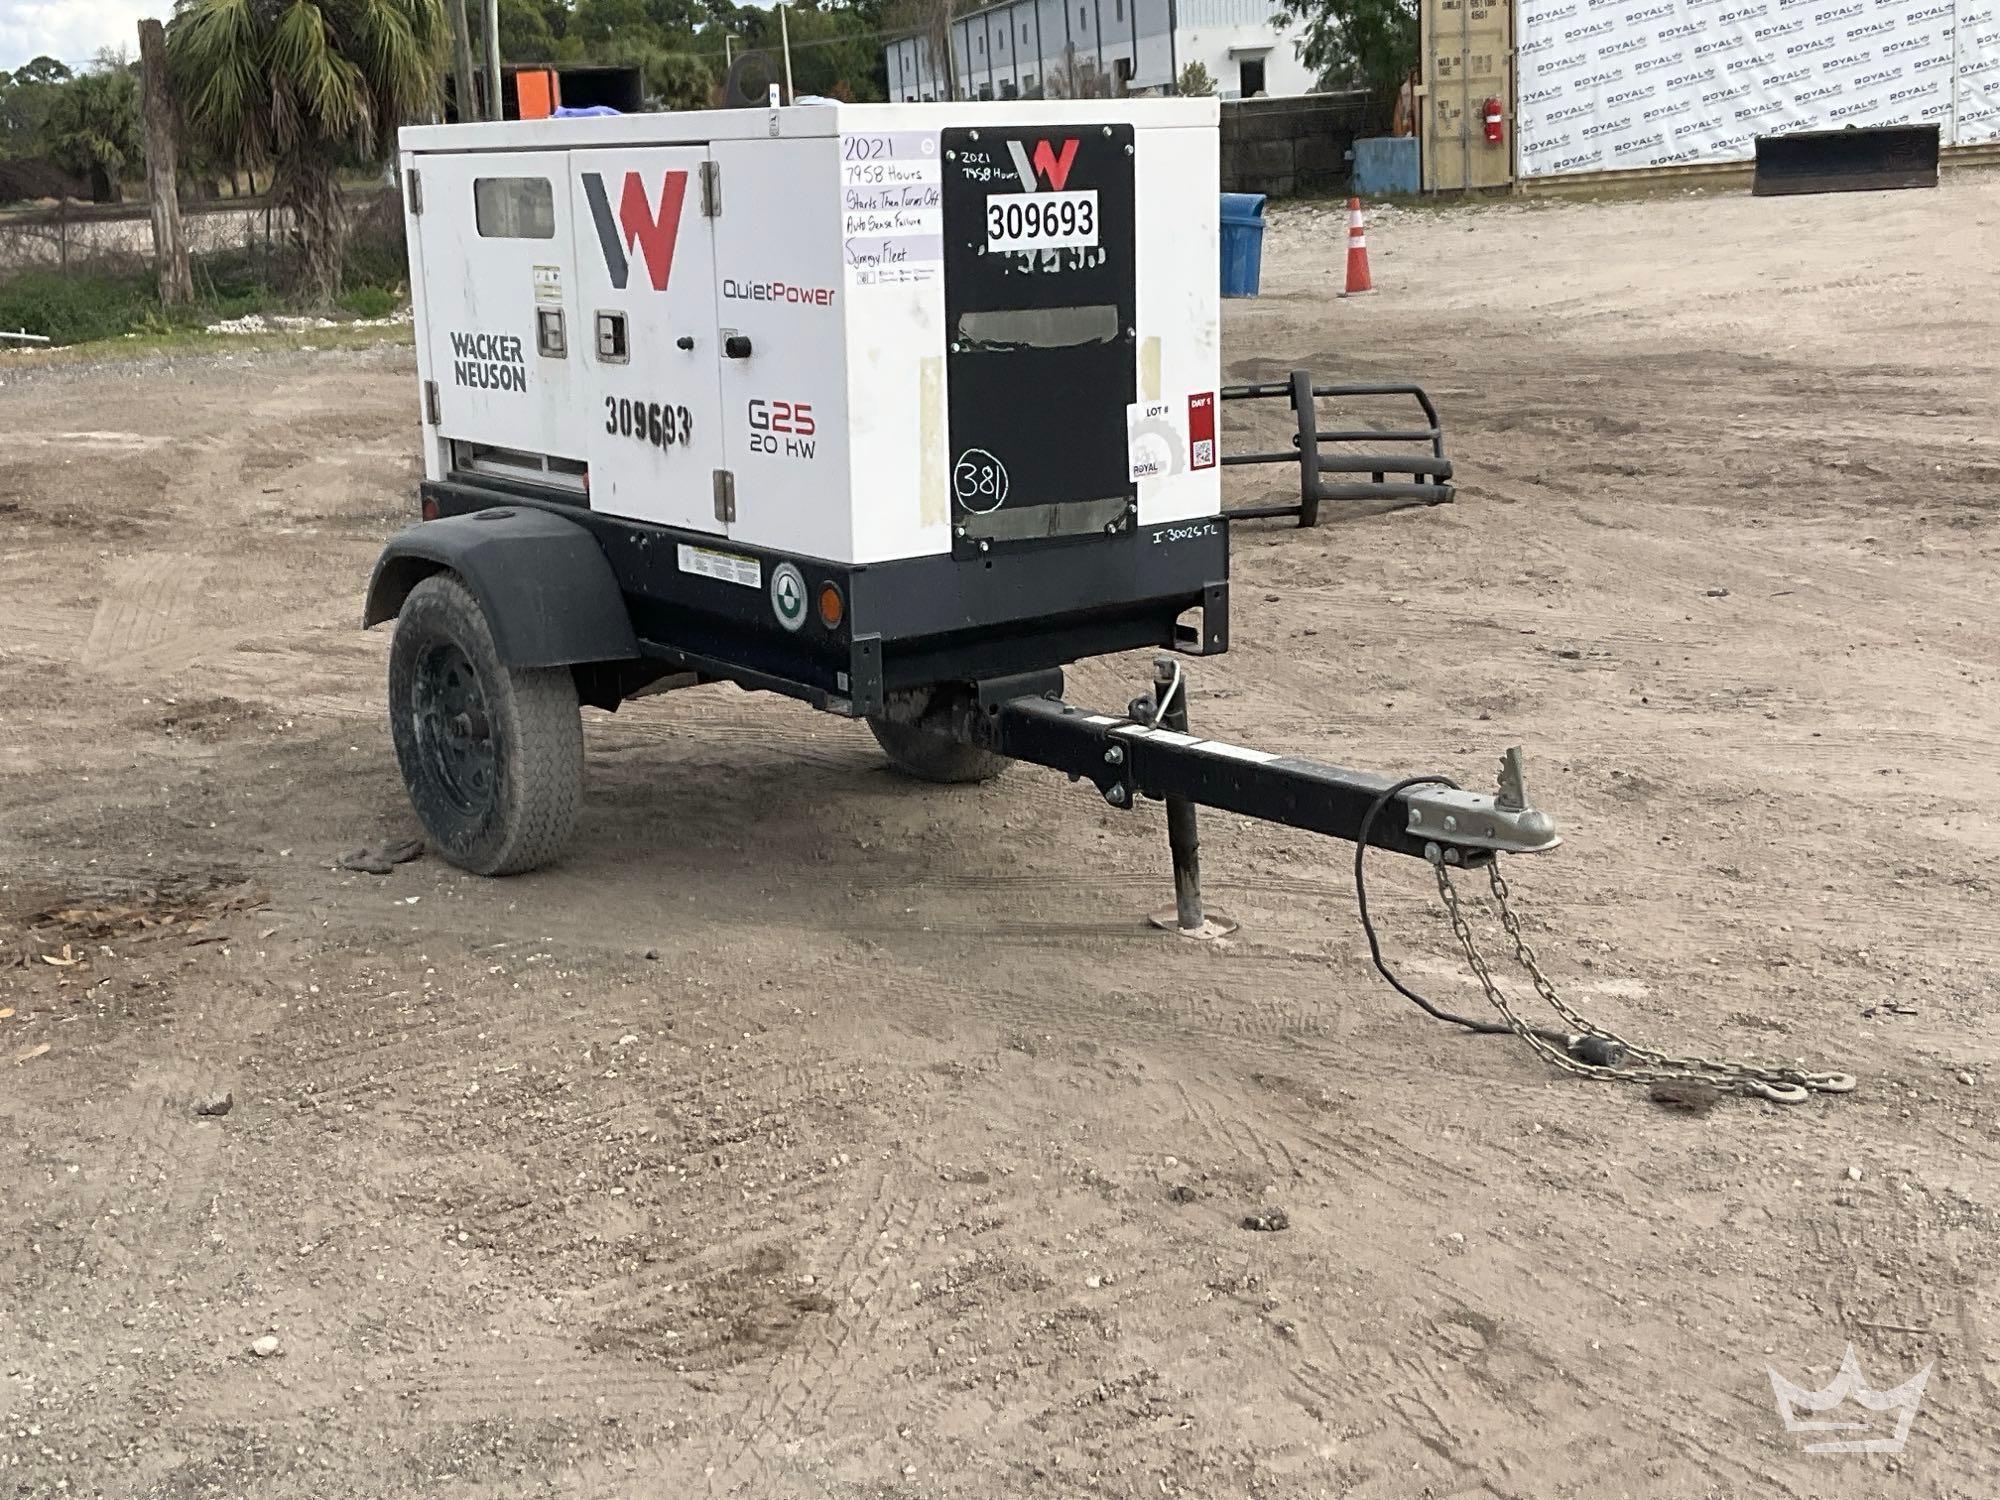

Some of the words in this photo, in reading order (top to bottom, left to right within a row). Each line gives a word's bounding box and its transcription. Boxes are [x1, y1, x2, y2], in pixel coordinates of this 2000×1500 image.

[1527, 8, 1567, 24] ROYAL
[1626, 7, 1665, 22] ROYAL
[1719, 8, 1757, 22] ROYAL
[1815, 6, 1853, 21] ROYAL
[1907, 6, 1946, 21] ROYAL
[1565, 24, 1603, 39] ROYAL
[1658, 23, 1696, 38] ROYAL
[1755, 23, 1792, 38] ROYAL
[1847, 24, 1883, 38] ROYAL
[1598, 40, 1637, 55] ROYAL
[1694, 40, 1732, 54] ROYAL
[1787, 39, 1824, 54] ROYAL
[1882, 38, 1920, 53] ROYAL
[1537, 57, 1576, 72] ROYAL
[1635, 55, 1672, 71] ROYAL
[1727, 56, 1765, 70] ROYAL
[1823, 54, 1861, 69] ROYAL
[1914, 54, 1952, 69] ROYAL
[1574, 73, 1612, 88] ROYAL
[1667, 72, 1705, 87] ROYAL
[1763, 70, 1800, 86] ROYAL
[1854, 71, 1890, 85] ROYAL
[1607, 89, 1645, 103] ROYAL
[1702, 86, 1740, 102] ROYAL
[1794, 88, 1832, 102] ROYAL
[1890, 86, 1926, 100] ROYAL
[1546, 106, 1584, 120] ROYAL
[1643, 105, 1679, 119] ROYAL
[1735, 104, 1772, 118] ROYAL
[1830, 102, 1866, 117] ROYAL
[1959, 110, 1993, 122] ROYAL
[1582, 121, 1620, 136] ROYAL
[1675, 121, 1712, 135] ROYAL
[1771, 118, 1809, 133] ROYAL
[845, 137, 893, 160] 2021
[1614, 137, 1653, 152] ROYAL
[1711, 135, 1751, 150] ROYAL
[960, 152, 990, 164] 2021
[1553, 154, 1592, 169] ROYAL
[1650, 150, 1688, 165] ROYAL
[845, 165, 884, 184] 7958
[888, 165, 922, 180] Hours
[962, 167, 991, 181] 7958
[847, 189, 876, 210] Starts
[880, 190, 899, 208] Then
[901, 186, 923, 206] Turns
[924, 187, 939, 205] Off
[847, 215, 865, 234] Auto
[868, 215, 892, 231] Sense
[895, 210, 921, 227] Failure
[988, 200, 1093, 240] 309693
[883, 241, 907, 263] Fleet
[723, 279, 835, 306] QuietPower
[450, 331, 524, 363] WACKER
[455, 360, 526, 393] NEUSON
[1191, 399, 1205, 408] DAY
[748, 399, 815, 435] G25
[1146, 407, 1162, 417] LOT
[605, 395, 692, 449] 309693
[750, 433, 778, 454] 20
[1133, 463, 1158, 474] ROYAL
[958, 463, 1000, 499] 381
